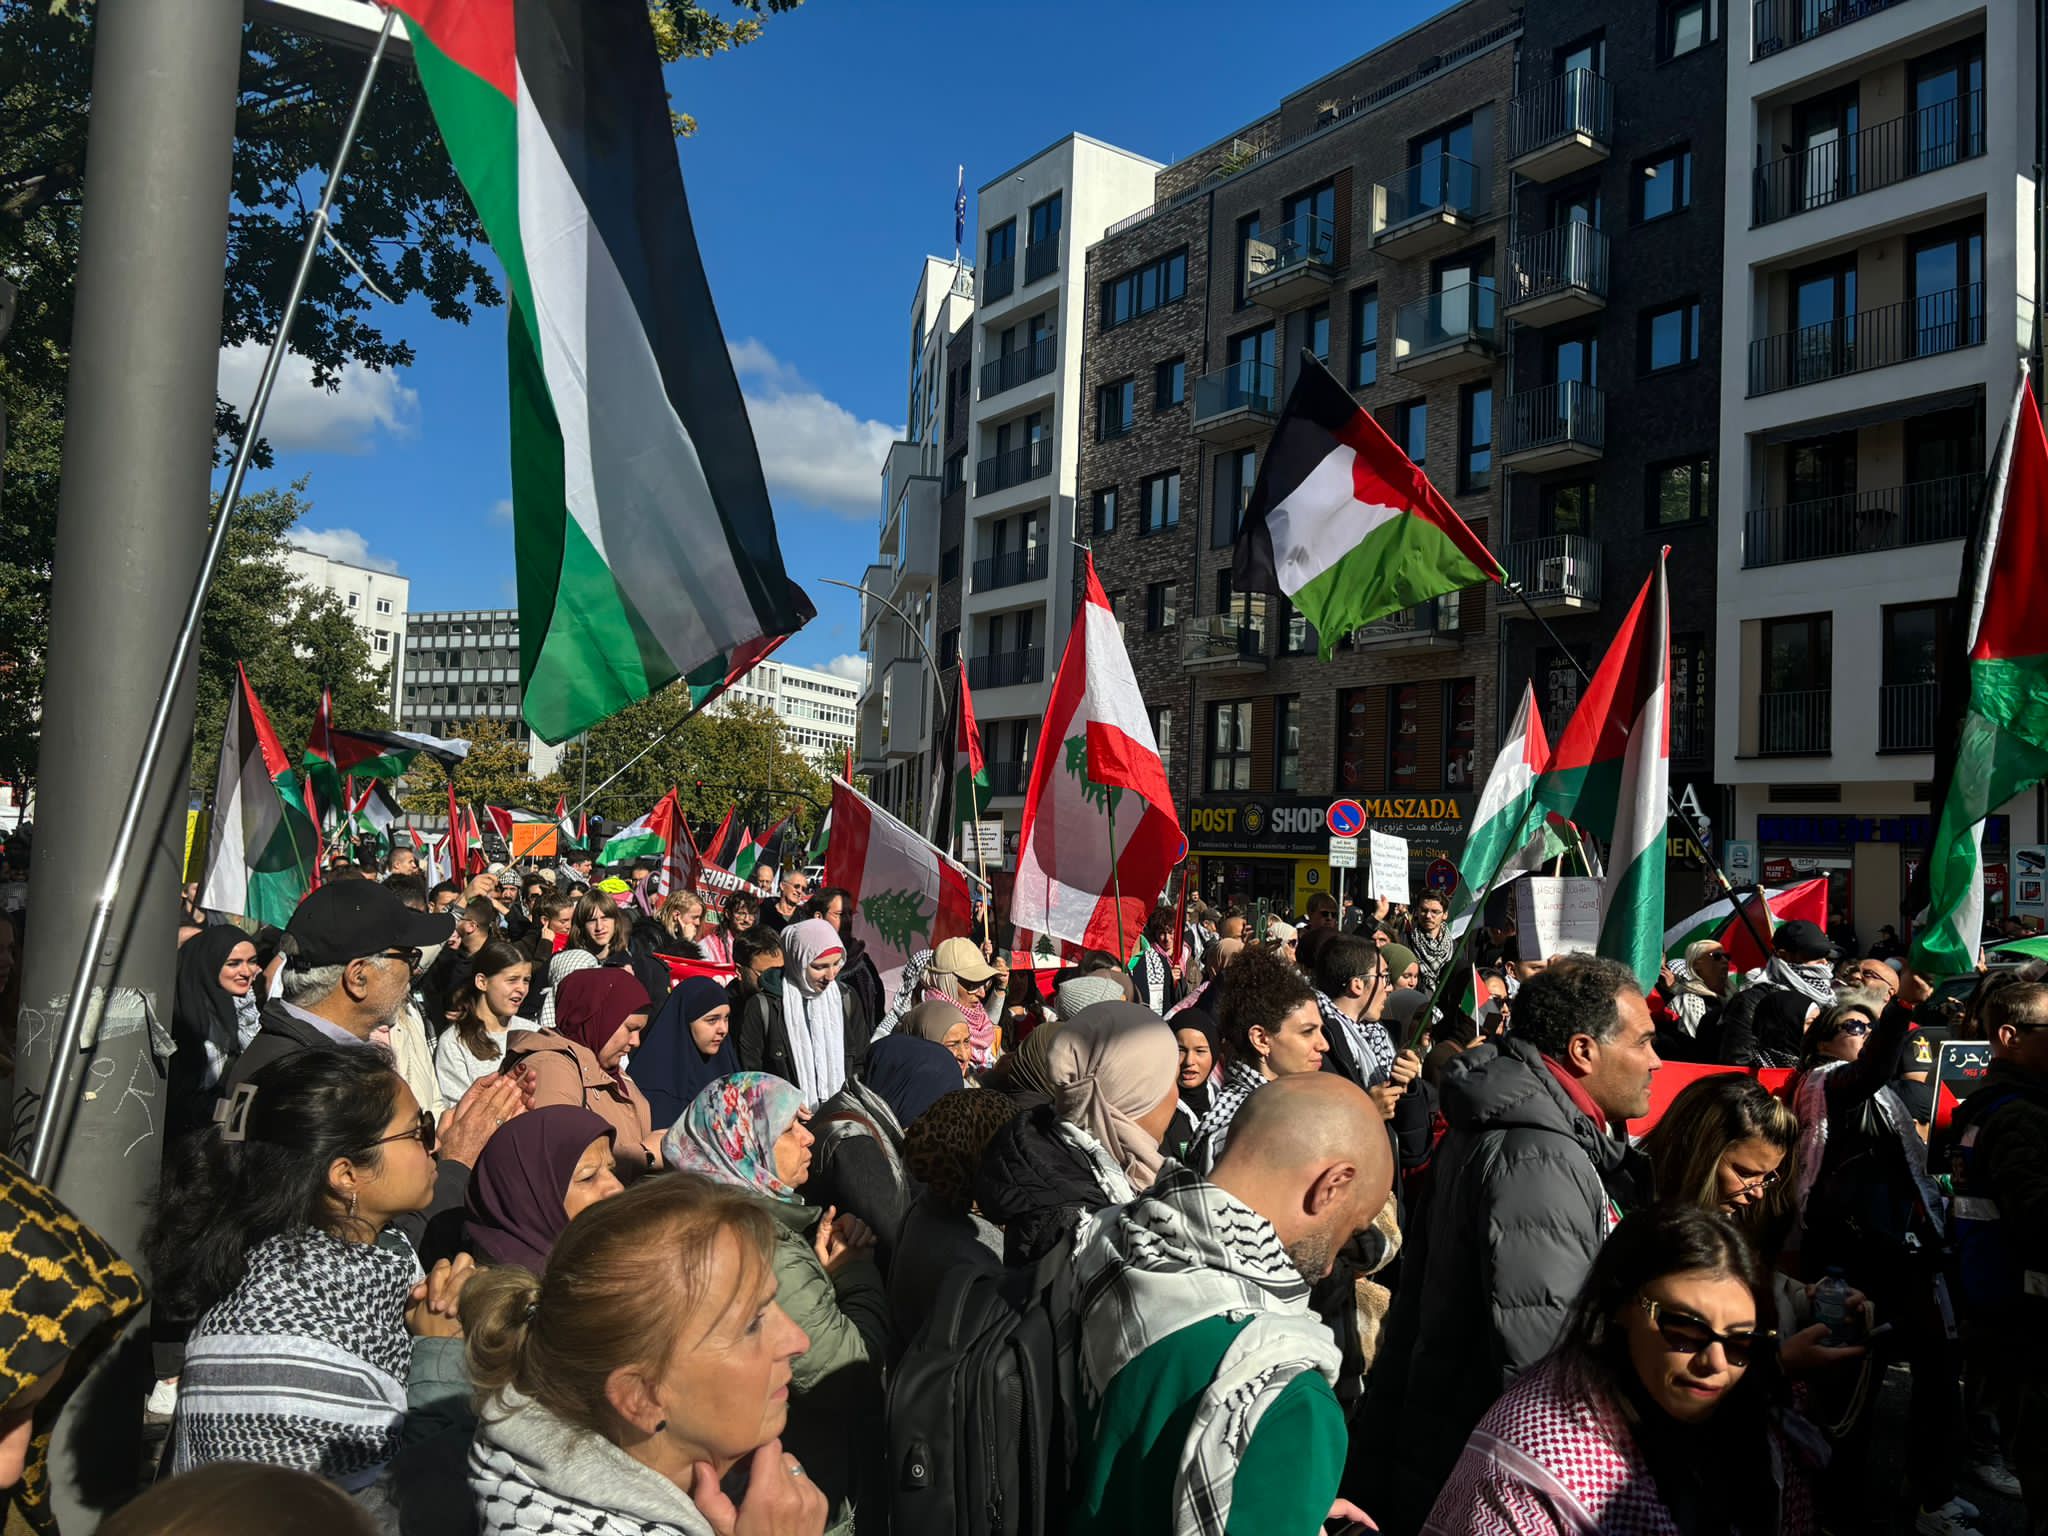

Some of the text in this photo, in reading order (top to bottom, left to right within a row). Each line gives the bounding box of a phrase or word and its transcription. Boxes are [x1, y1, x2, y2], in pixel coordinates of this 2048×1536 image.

[1358, 798, 1462, 819] MASZADA
[1191, 808, 1238, 833] POST
[1271, 808, 1325, 833] SHOP
[699, 868, 746, 892] EIHEIT
[1949, 1047, 1980, 1069] حرة
